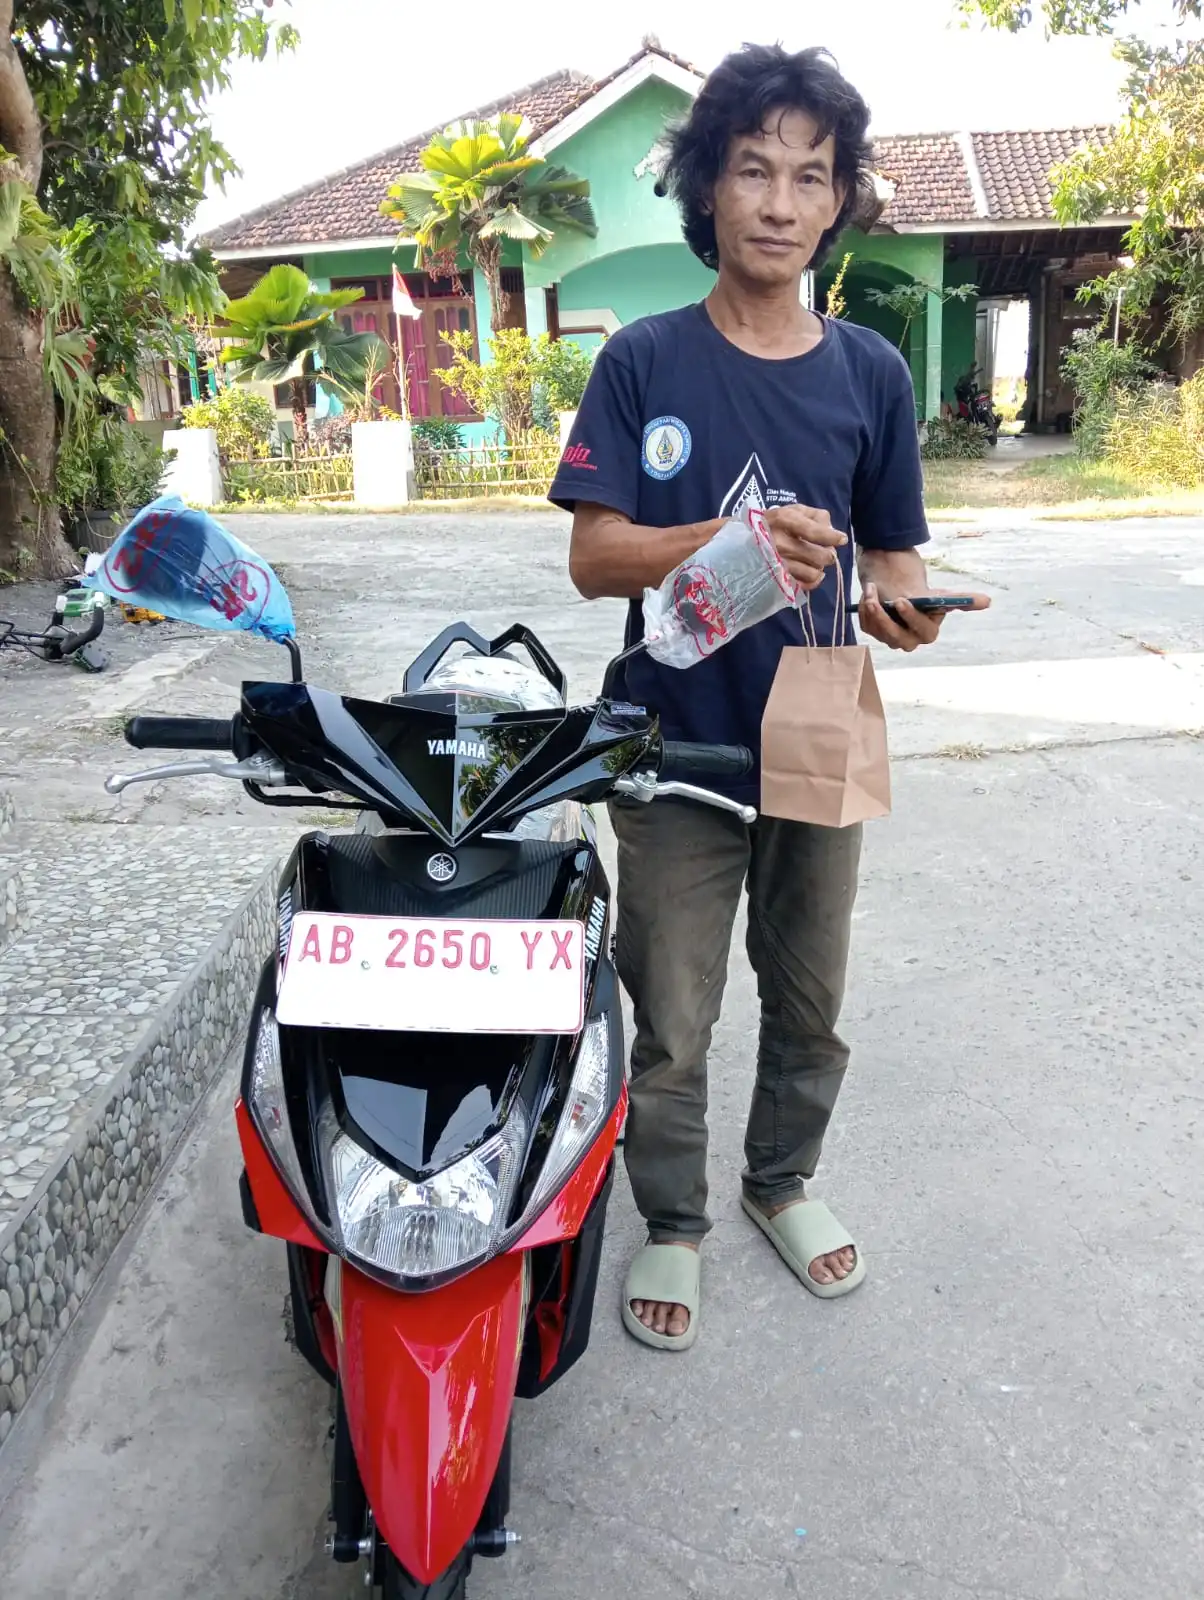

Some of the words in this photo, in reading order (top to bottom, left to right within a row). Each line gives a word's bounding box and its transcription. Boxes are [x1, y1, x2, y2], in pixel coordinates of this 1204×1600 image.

[427, 739, 486, 759] YAMAHA
[298, 923, 354, 965] AB
[384, 928, 492, 971] 2650
[519, 929, 573, 970] YX
[584, 895, 607, 961] YAMAHA
